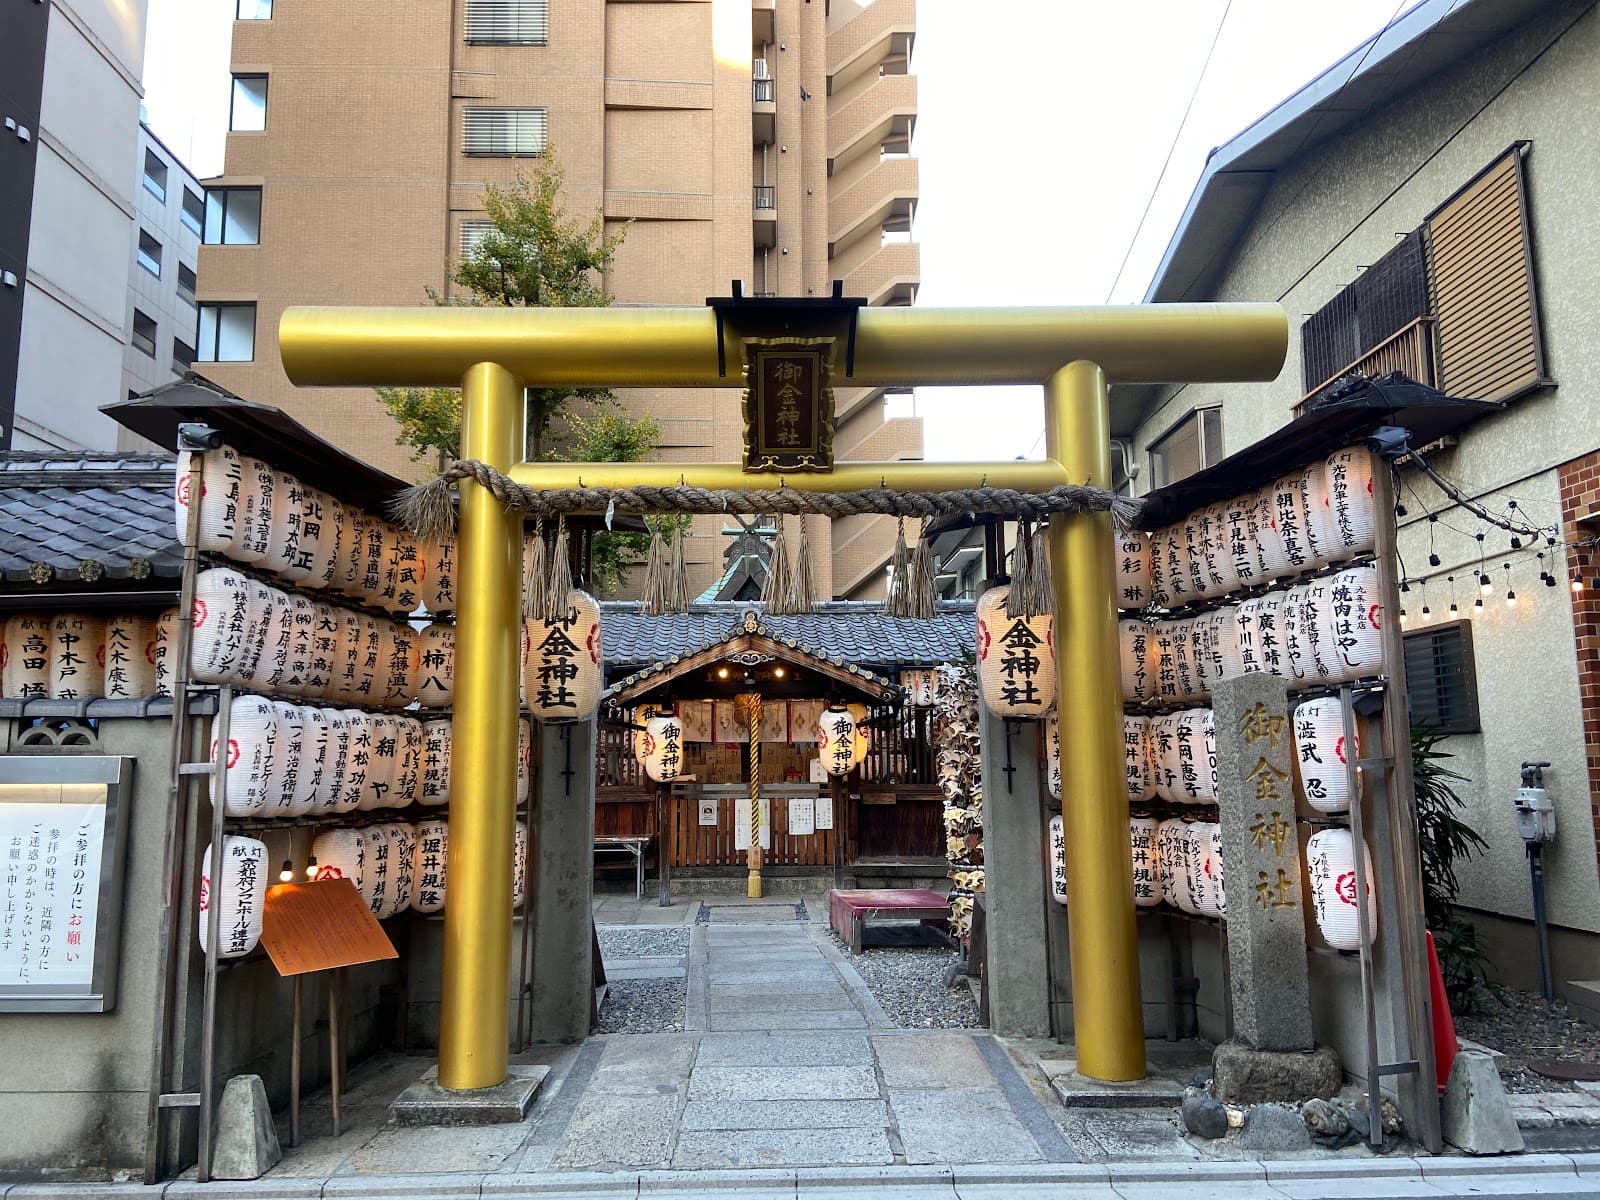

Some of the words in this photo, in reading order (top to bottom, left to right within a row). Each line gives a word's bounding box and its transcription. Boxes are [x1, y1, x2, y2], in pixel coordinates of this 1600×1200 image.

[774, 360, 803, 446] 御金神社
[215, 462, 242, 541] 三島良二
[1276, 492, 1306, 567] 朝比奈真吾
[432, 544, 454, 603] 下村春代
[1226, 511, 1253, 580] 早見雄二郎
[1331, 584, 1362, 667] 焼肉はやし
[420, 648, 449, 692] 柿八
[1131, 634, 1147, 699] 石橋ピアノサービス
[370, 736, 397, 800] 絹や
[661, 722, 681, 781] 御金神社
[832, 716, 853, 774] 御金神社
[1240, 701, 1298, 911] 御金神社
[232, 846, 262, 857] 献灯
[1133, 836, 1155, 898] 堀井規隆
[2, 836, 22, 951] お願い申し上げます
[19, 823, 42, 984] ご迷惑のかからないように、
[225, 857, 259, 954] 京都府ソフトボール連盟
